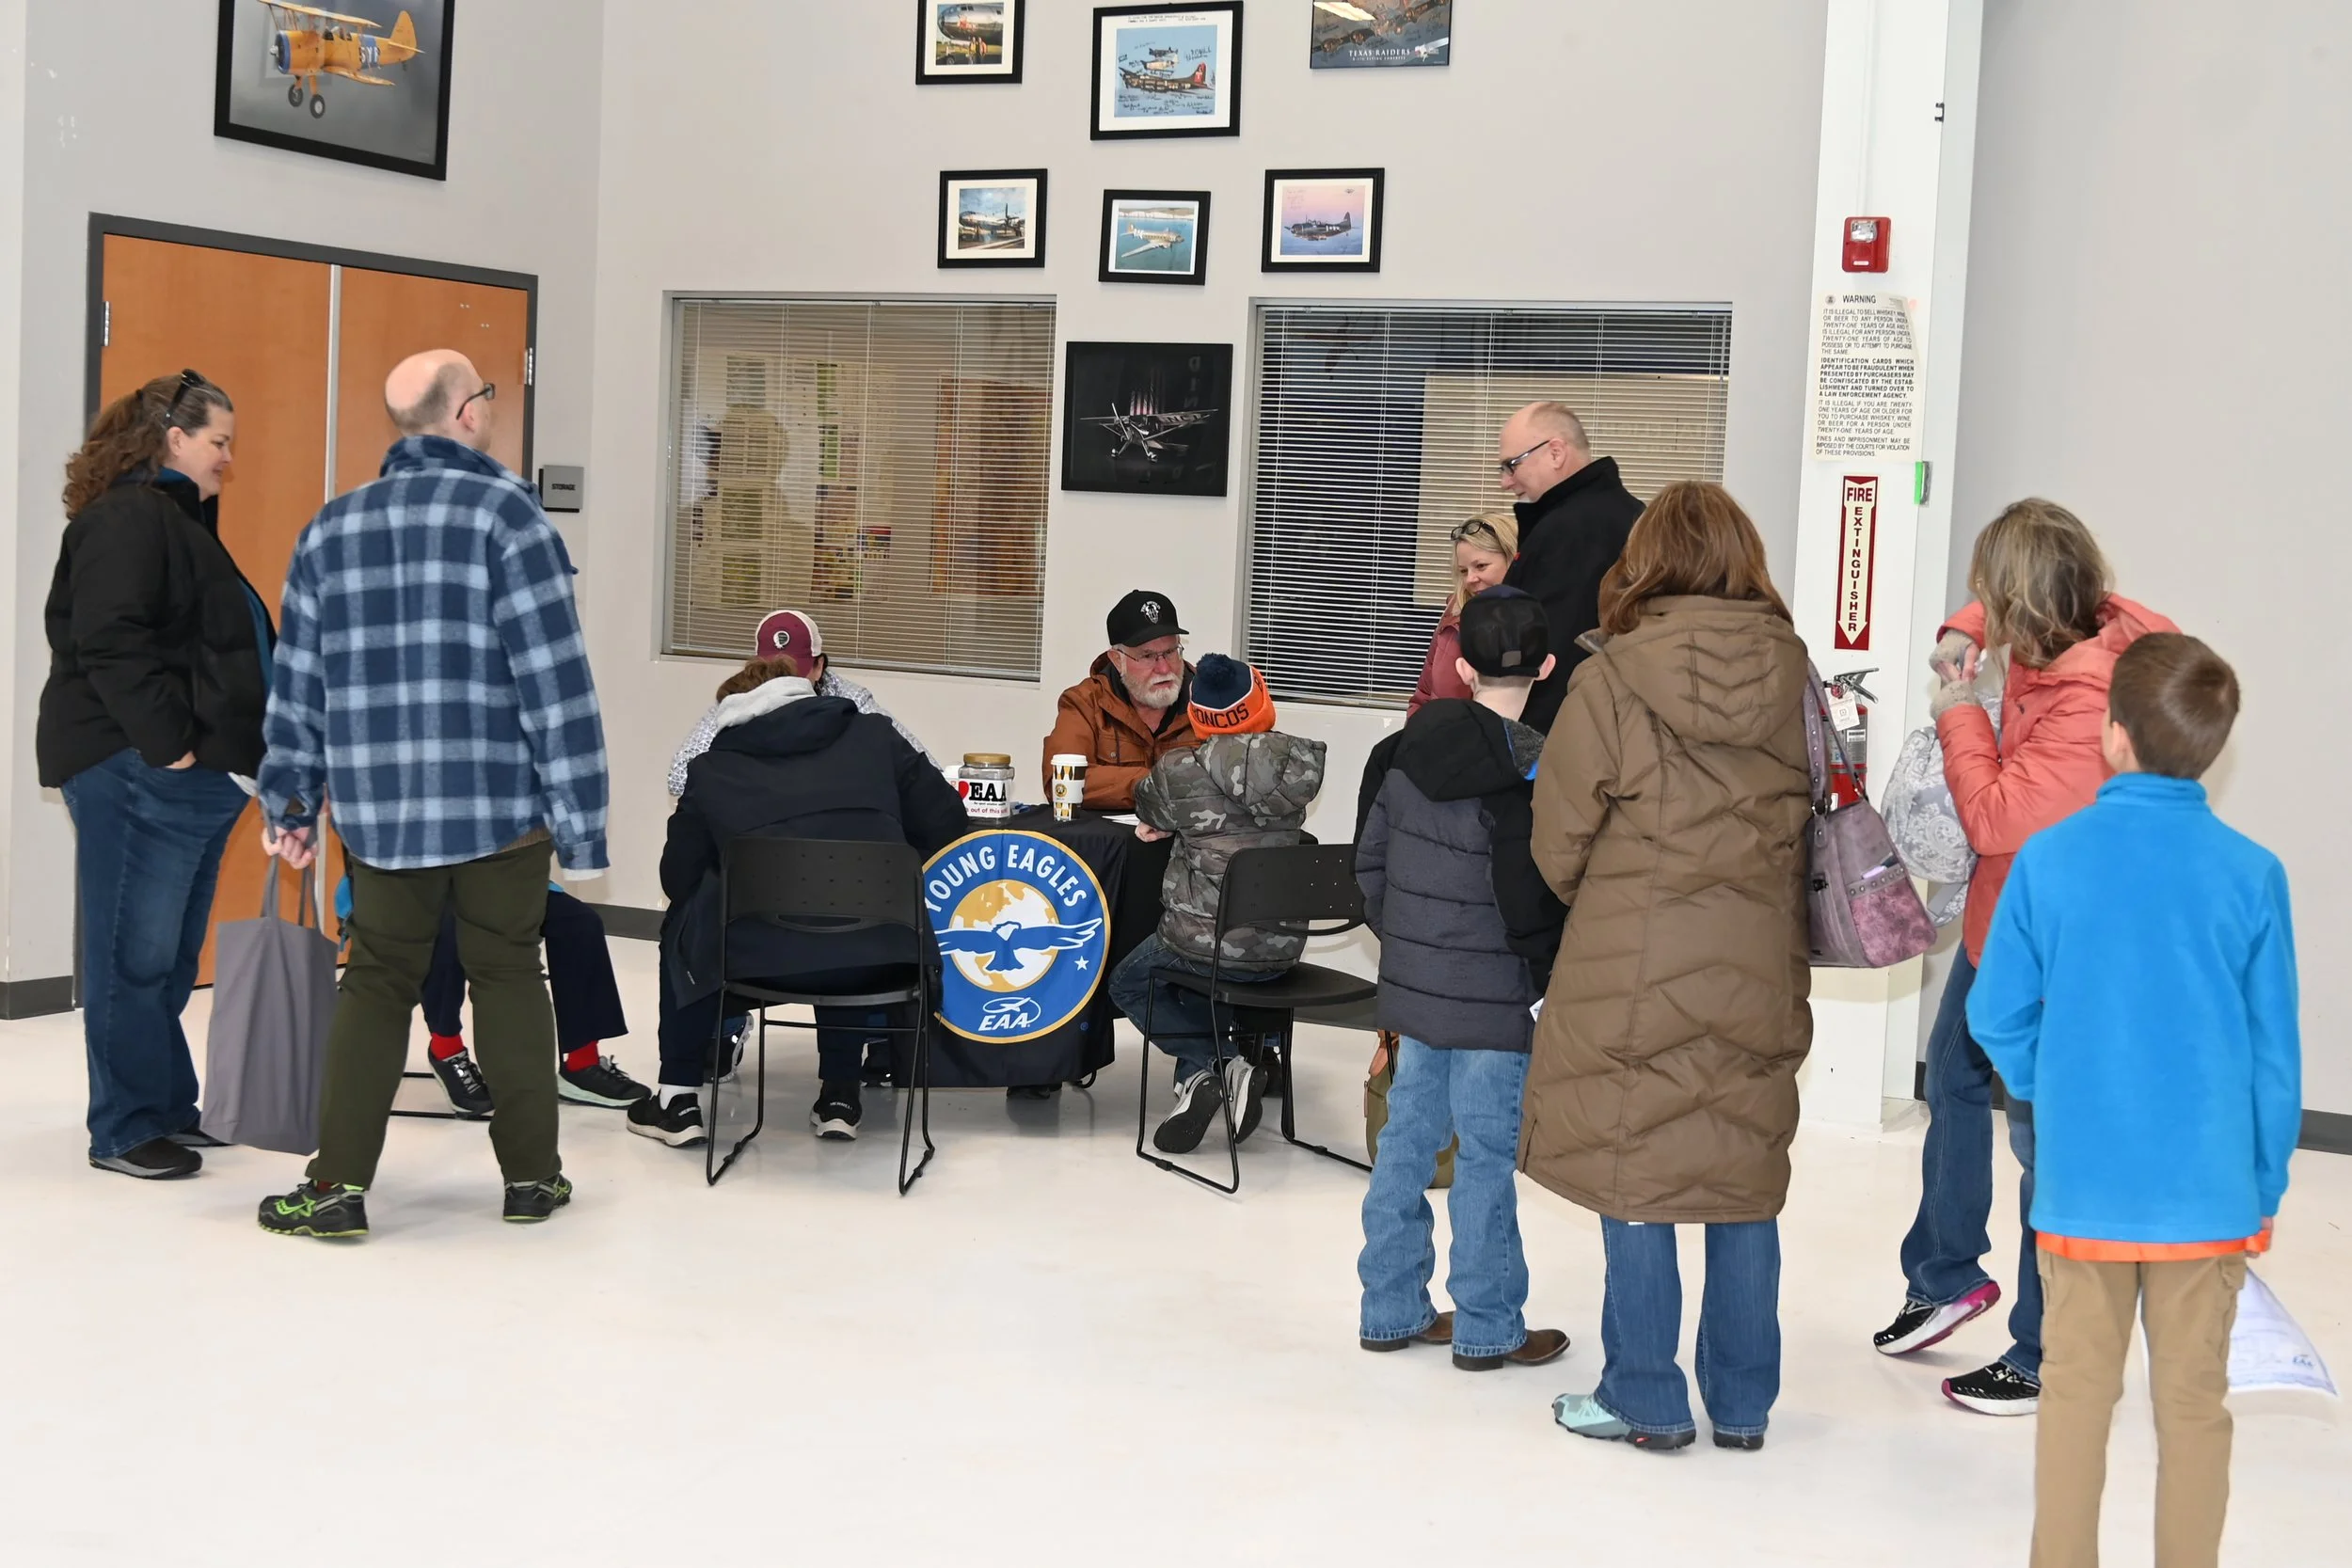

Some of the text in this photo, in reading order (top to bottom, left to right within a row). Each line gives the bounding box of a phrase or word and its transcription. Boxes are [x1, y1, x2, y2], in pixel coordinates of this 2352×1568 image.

[1843, 295, 1876, 303] WARNING
[1847, 487, 1873, 502] FIRE
[1848, 507, 1863, 632] EXTINGUISHER
[1193, 703, 1249, 728] ONCOS
[925, 845, 1087, 912] YOUNG EAGLES
[978, 1013, 1029, 1031] EAA
